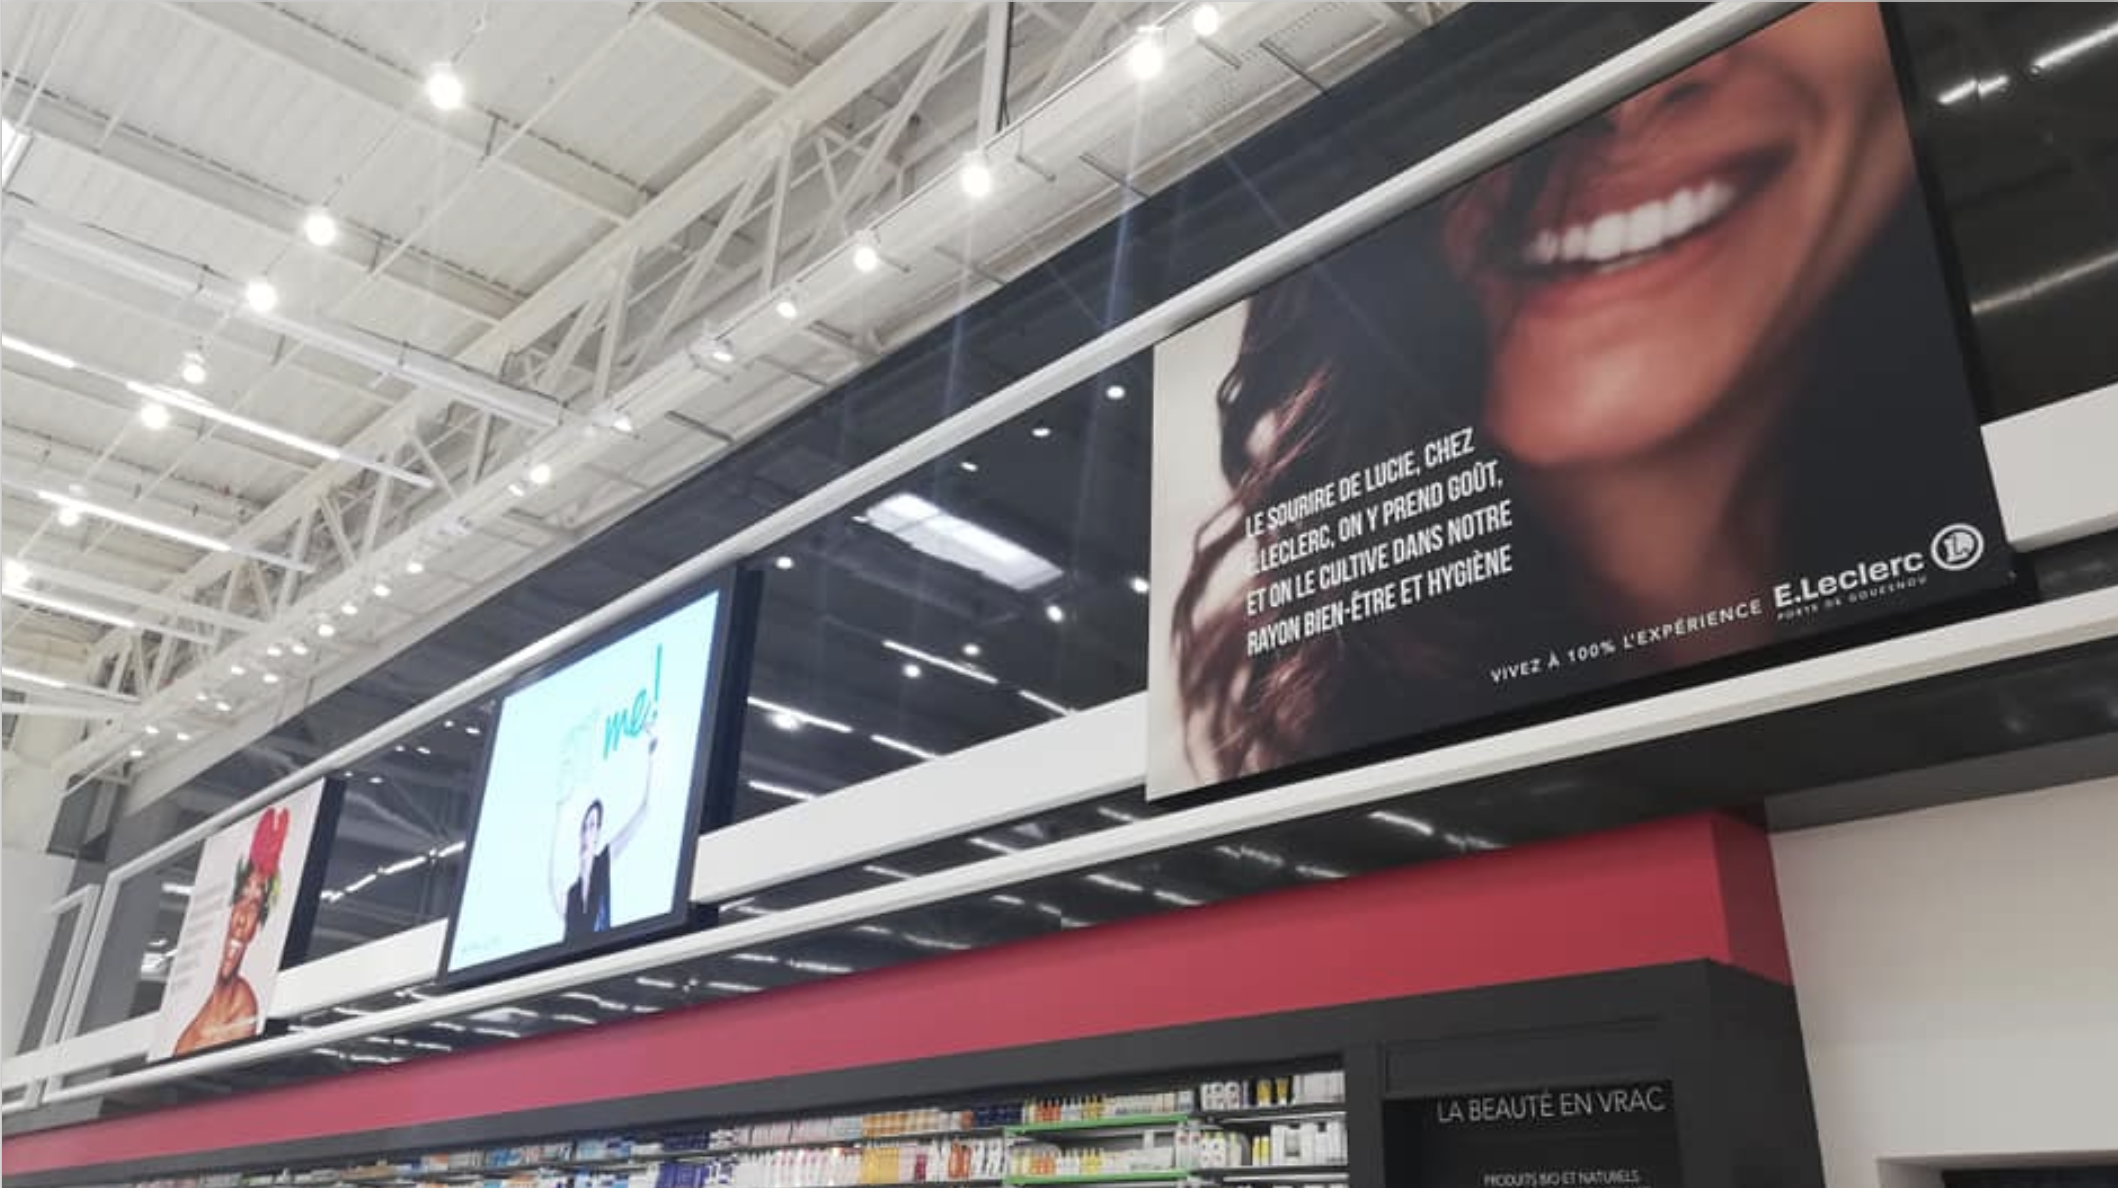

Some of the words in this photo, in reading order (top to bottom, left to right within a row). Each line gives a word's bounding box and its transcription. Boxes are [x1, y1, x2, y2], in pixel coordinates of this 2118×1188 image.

[1245, 510, 1265, 538] LE
[1267, 482, 1336, 530] SOURIRE
[1338, 471, 1362, 502] DE
[1364, 451, 1420, 492] LUCIE,
[1424, 426, 1475, 469] CHEZ
[1338, 510, 1363, 542] ON
[1366, 503, 1379, 532] Y
[1382, 481, 1444, 525] PREND
[1448, 460, 1504, 501] GOÛT,
[1247, 587, 1268, 616] ET
[1269, 579, 1293, 608] ON
[1295, 567, 1317, 598] LE
[1319, 545, 1390, 590] CULTIVE
[1393, 523, 1443, 564] DANS
[1448, 500, 1513, 547] NOTRE
[1247, 617, 1301, 656] RAYON
[1303, 582, 1397, 637] BIEN-ÊTRE
[1400, 572, 1426, 606] ET
[1427, 544, 1513, 596] HYGIÈNE
[1773, 552, 1925, 608] E.Leclerc
[1490, 658, 1541, 683] VIVEZ
[1549, 652, 1561, 669] À
[1567, 639, 1616, 663] 100%
[1622, 598, 1762, 650] L'EXPÉRIENCE
[603, 643, 662, 761] me!
[1438, 1101, 1464, 1123] LA
[1468, 1087, 1555, 1121] BEAUTÉ
[1560, 1093, 1592, 1116] EN
[1597, 1086, 1666, 1112] VRAC
